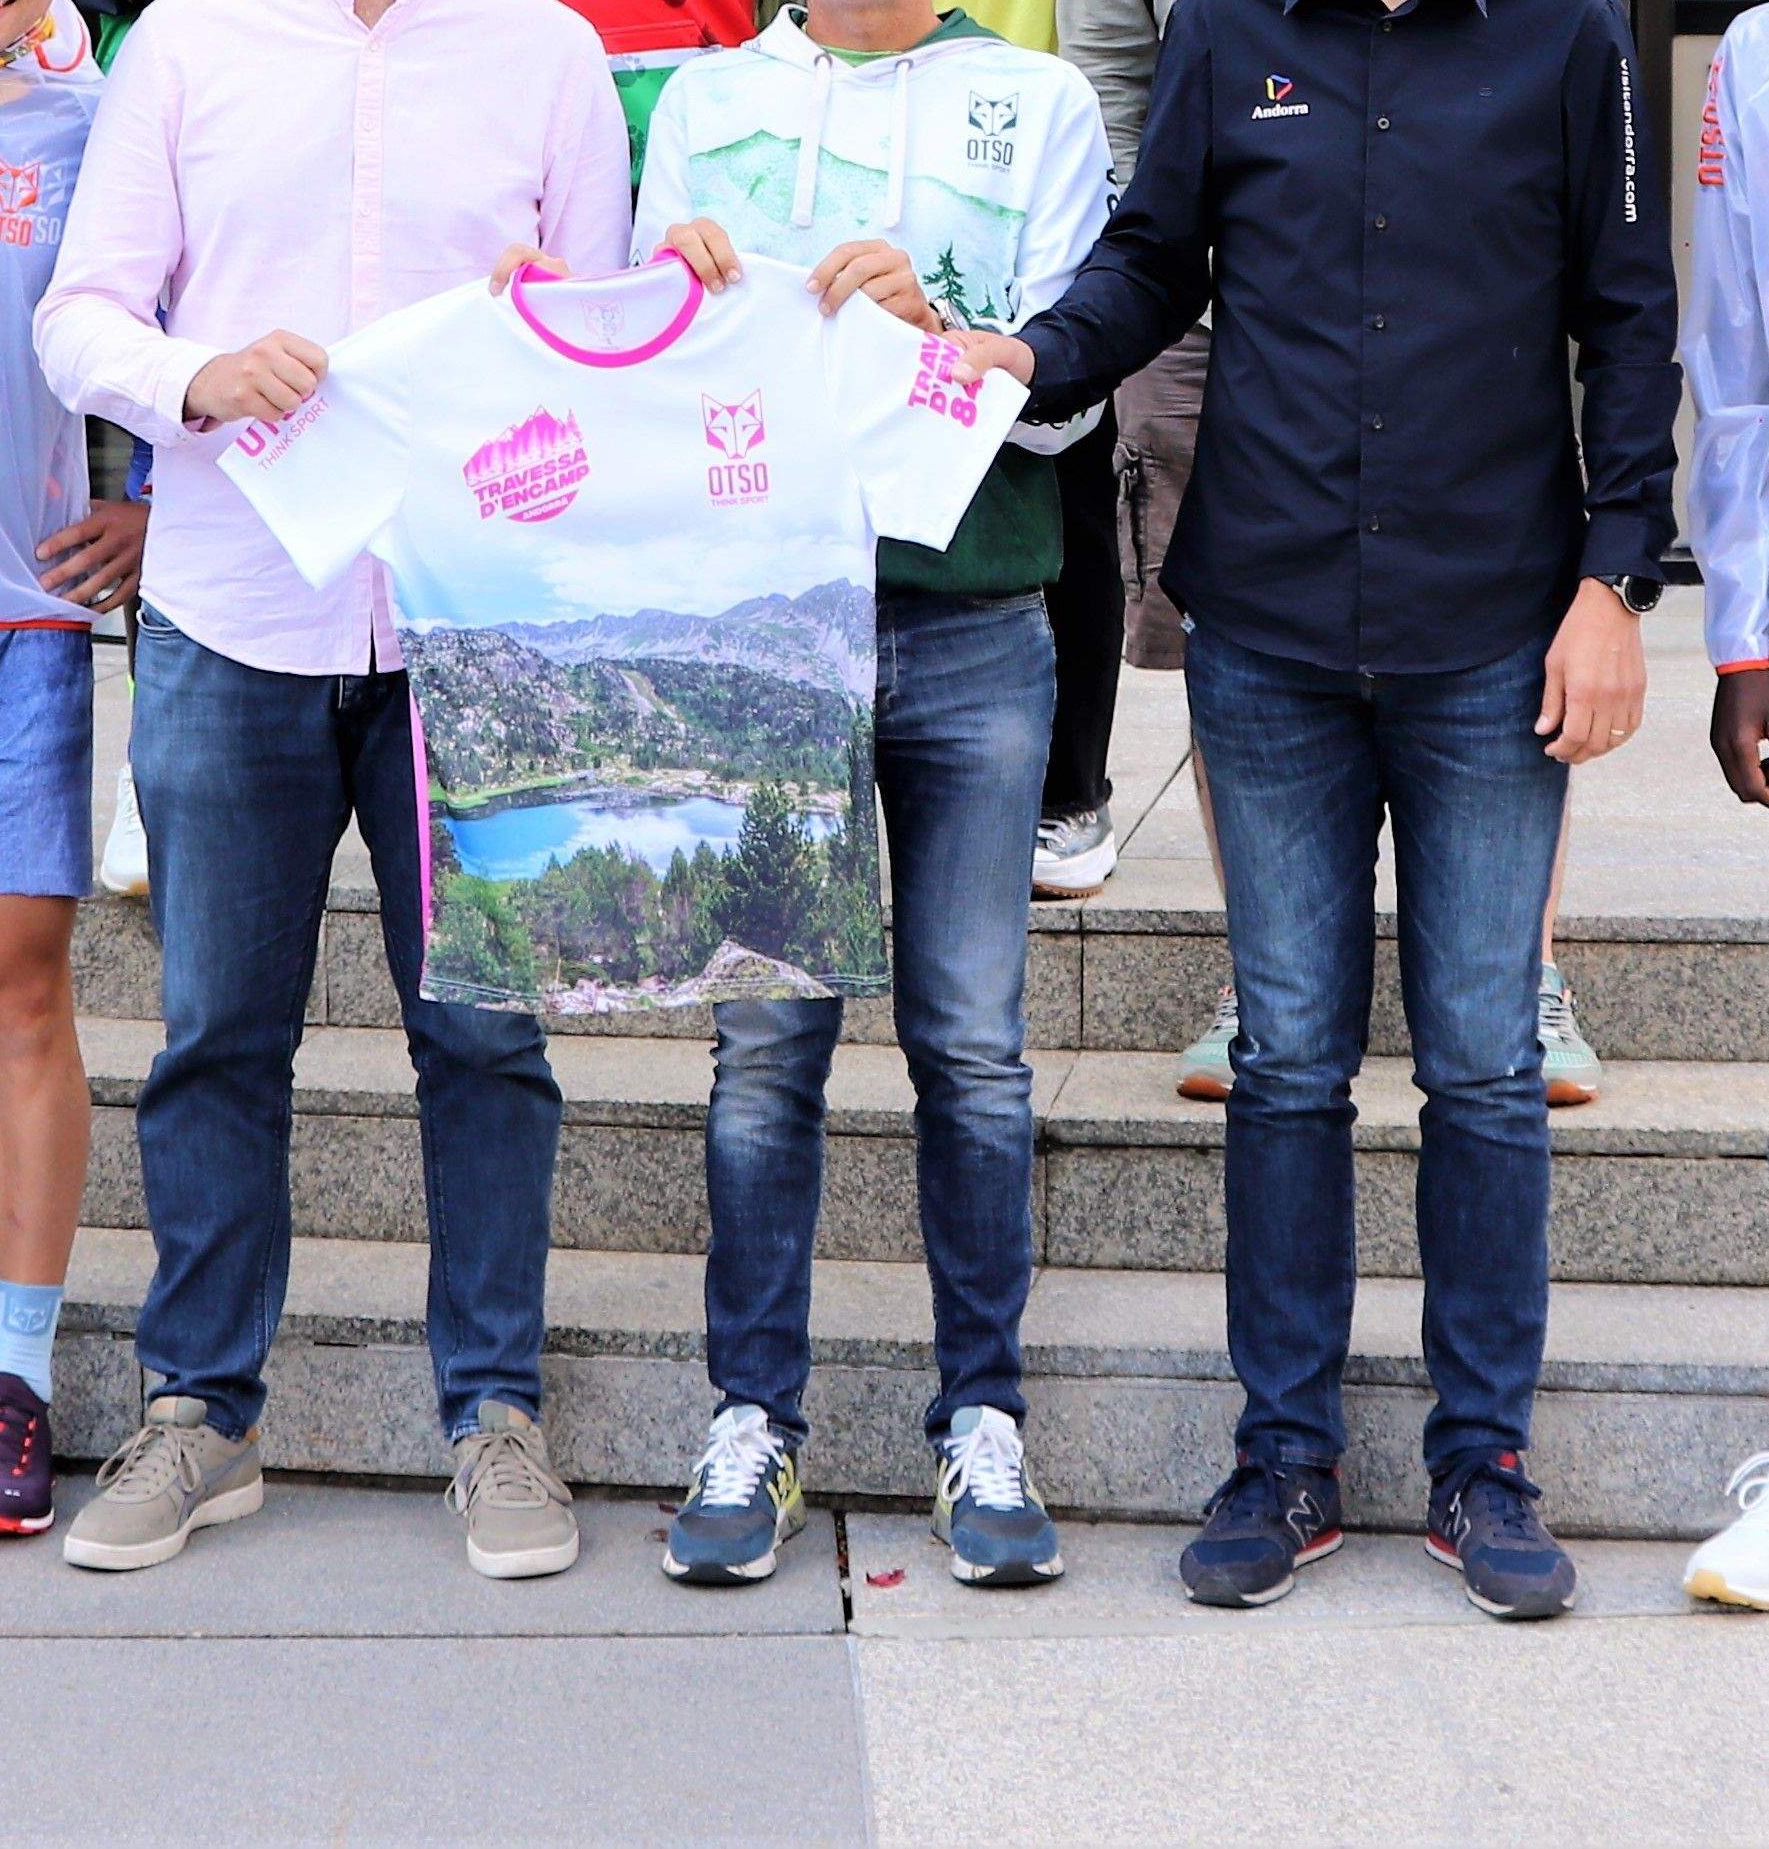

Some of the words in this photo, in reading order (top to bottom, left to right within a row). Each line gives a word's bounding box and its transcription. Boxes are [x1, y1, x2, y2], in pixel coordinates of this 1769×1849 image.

[1251, 102, 1309, 120] Andorra
[967, 138, 1015, 166] OTSO
[1620, 57, 1638, 223] visitandorra.com
[258, 434, 294, 471] THINK
[290, 396, 329, 438] SPORT
[473, 447, 588, 503] TRAVESSA
[480, 464, 590, 520] D'ENCAMP
[708, 462, 769, 496] OTSO
